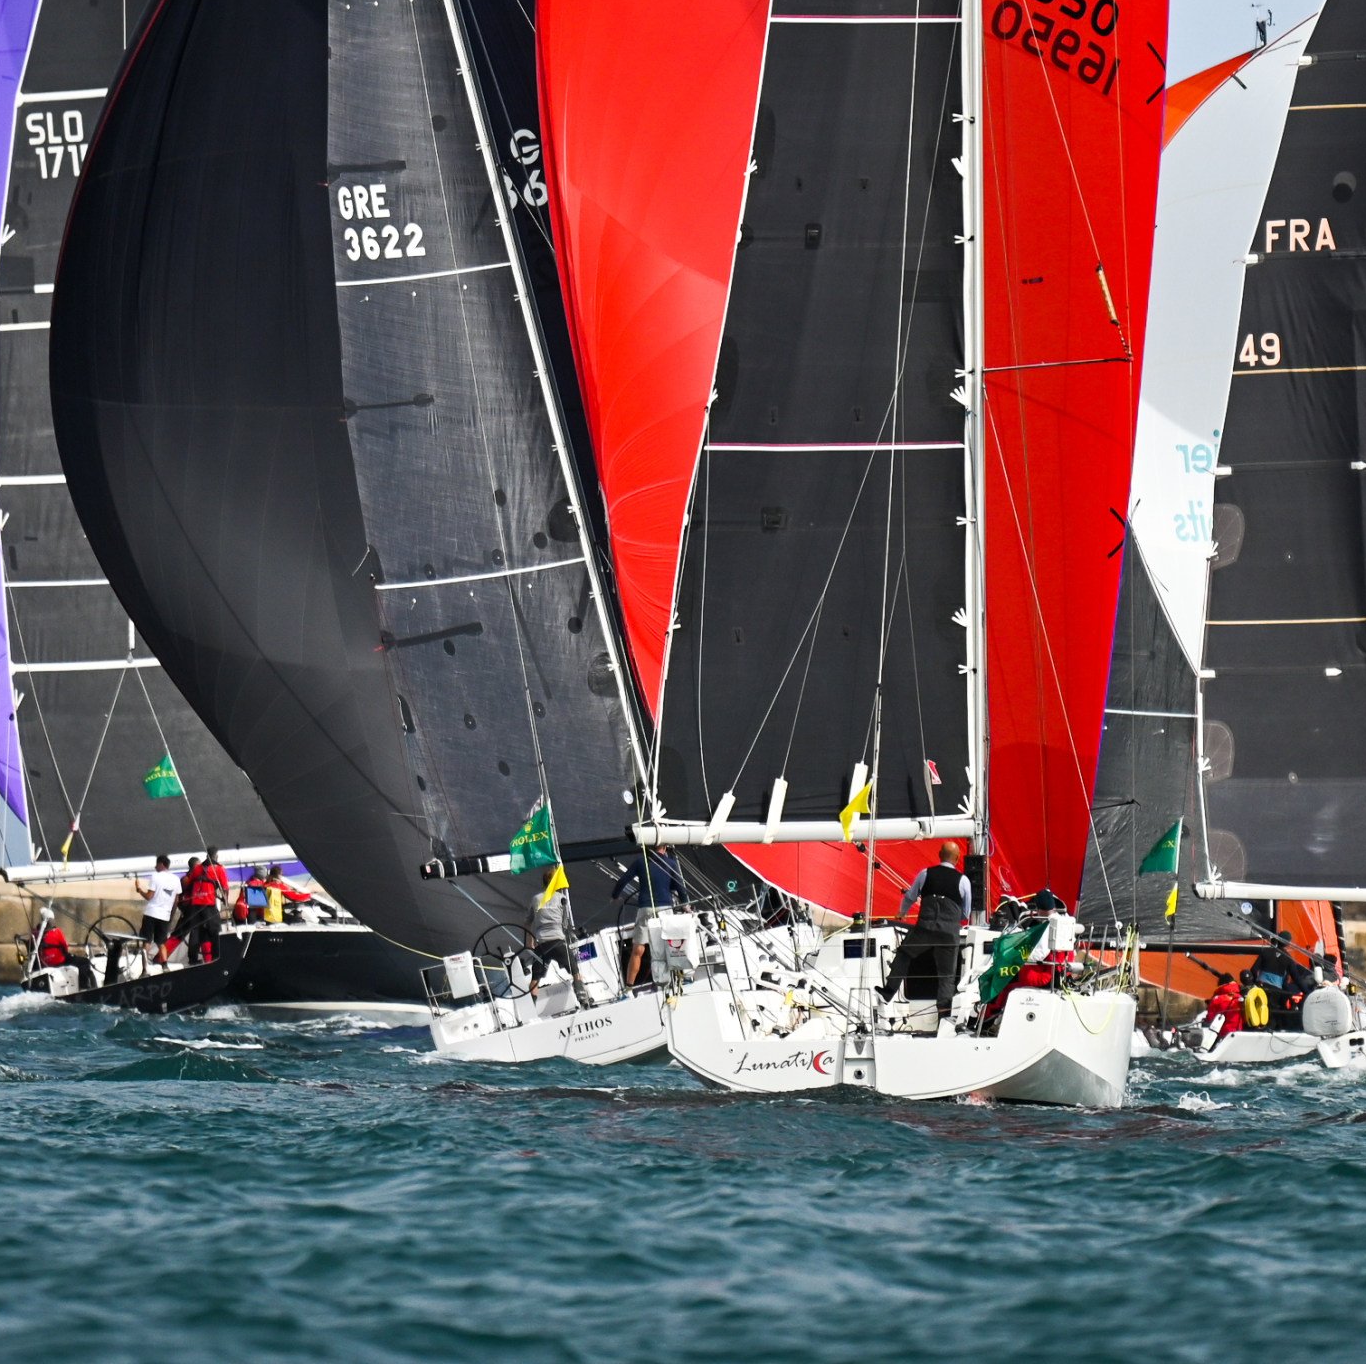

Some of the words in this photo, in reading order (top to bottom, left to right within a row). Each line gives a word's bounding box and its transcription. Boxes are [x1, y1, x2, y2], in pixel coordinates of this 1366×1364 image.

[26, 110, 84, 146] SLO
[338, 184, 390, 220] GRE
[344, 223, 426, 262] 3622
[1265, 218, 1336, 253] FRA
[1238, 332, 1282, 367] 49
[559, 1016, 613, 1039] AETHOS
